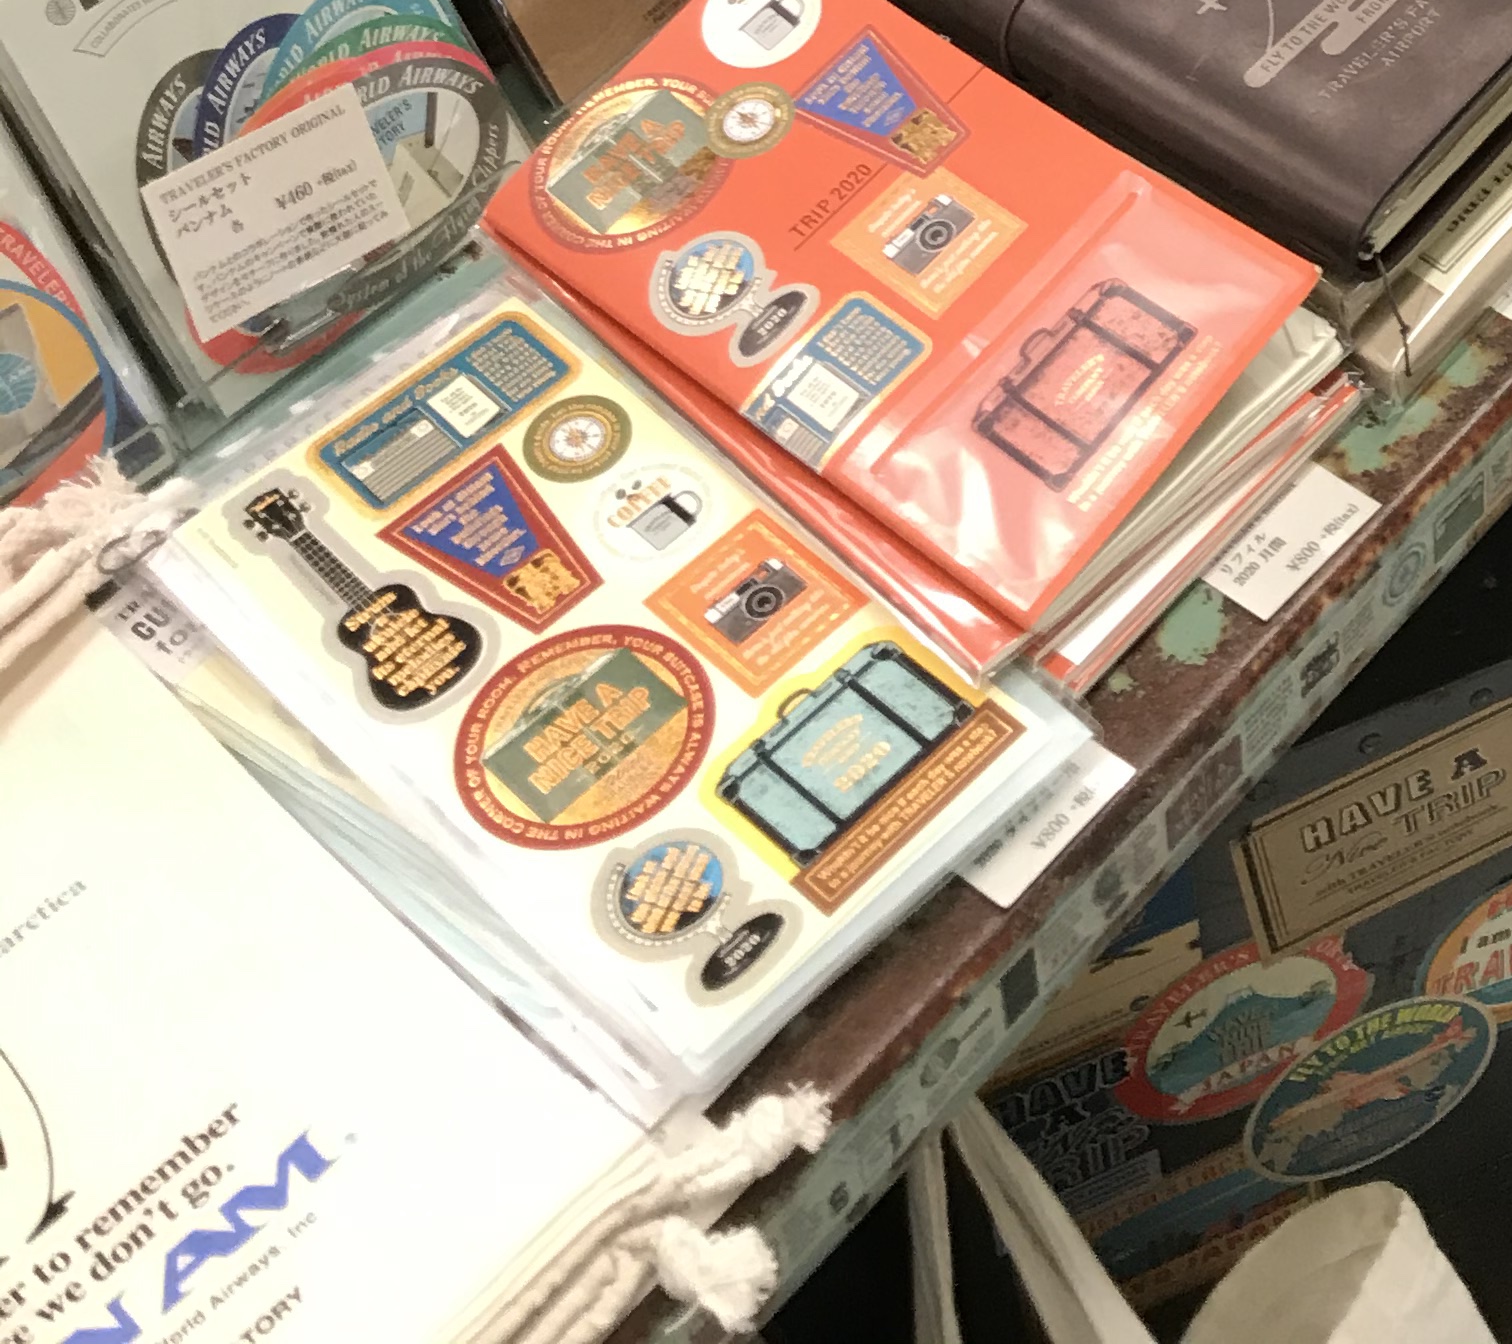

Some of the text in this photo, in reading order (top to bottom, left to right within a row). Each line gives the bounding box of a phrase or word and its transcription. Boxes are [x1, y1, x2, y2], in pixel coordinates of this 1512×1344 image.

[206, 26, 268, 116] AIRWAYS
[360, 23, 445, 53] AIRWAYS
[1260, 44, 1288, 74] FLY
[1282, 23, 1304, 50] TO
[1300, 1, 1328, 34] THE
[1380, 8, 1444, 68] AIRPORT
[400, 64, 486, 97] AIRWAYS
[142, 74, 188, 171] AIRWAYS
[159, 104, 347, 205] TRAVELER'S FACTORY ORIGINAL
[274, 180, 315, 211] ¥460
[787, 161, 873, 240] TRIP 2020
[1285, 538, 1322, 576] ¥800
[464, 635, 665, 765] YOUR YOUR
[523, 682, 625, 764] HAVE A
[528, 685, 652, 796] NICE TRIP
[834, 739, 892, 794] 2020
[1300, 746, 1488, 854] HAVE A
[1391, 767, 1508, 836] TRIP
[1476, 927, 1512, 949] am
[1201, 1043, 1300, 1093] JAPAN
[74, 1102, 242, 1254] remember
[35, 1278, 88, 1324] we
[89, 1191, 180, 1283] don't
[180, 1161, 237, 1209] go.
[161, 1124, 342, 1314] AM
[32, 1248, 73, 1286] to
